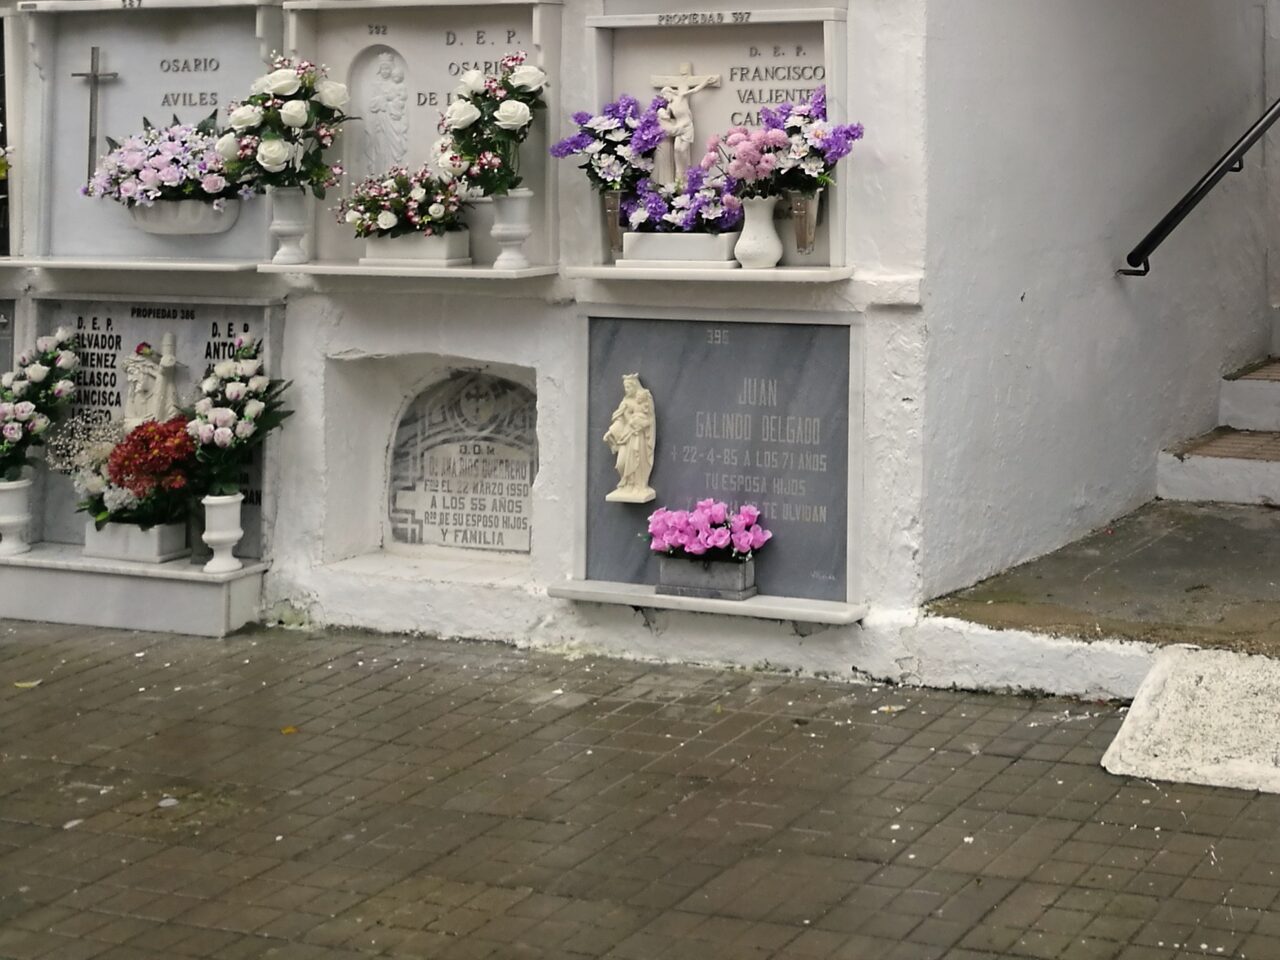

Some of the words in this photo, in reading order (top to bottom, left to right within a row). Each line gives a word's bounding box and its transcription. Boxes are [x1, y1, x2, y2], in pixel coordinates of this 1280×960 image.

[657, 13, 724, 25] PROPIEDAD
[159, 57, 220, 72] OSARIO
[729, 65, 826, 82] FRANCISCO
[161, 92, 218, 107] AVILES
[417, 92, 439, 106] DE
[131, 307, 178, 319] PROPIEDAD
[738, 377, 778, 406] JUAN
[695, 411, 751, 441] GALINDO
[761, 415, 820, 445] DELGADO
[756, 451, 778, 469] LOS
[799, 450, 827, 472] AÑOS
[472, 482, 504, 496] MARZO
[722, 474, 767, 494] ESPOSA
[772, 476, 806, 496] HIJOS
[442, 497, 465, 510] LOS
[470, 498, 487, 512] 55
[491, 498, 523, 514] AÑOS
[782, 503, 827, 523] OLVIDAN
[452, 513, 464, 526] SU
[465, 513, 500, 528] ESPOSO
[502, 515, 528, 530] HIJOS
[454, 529, 504, 546] FAMILIA
